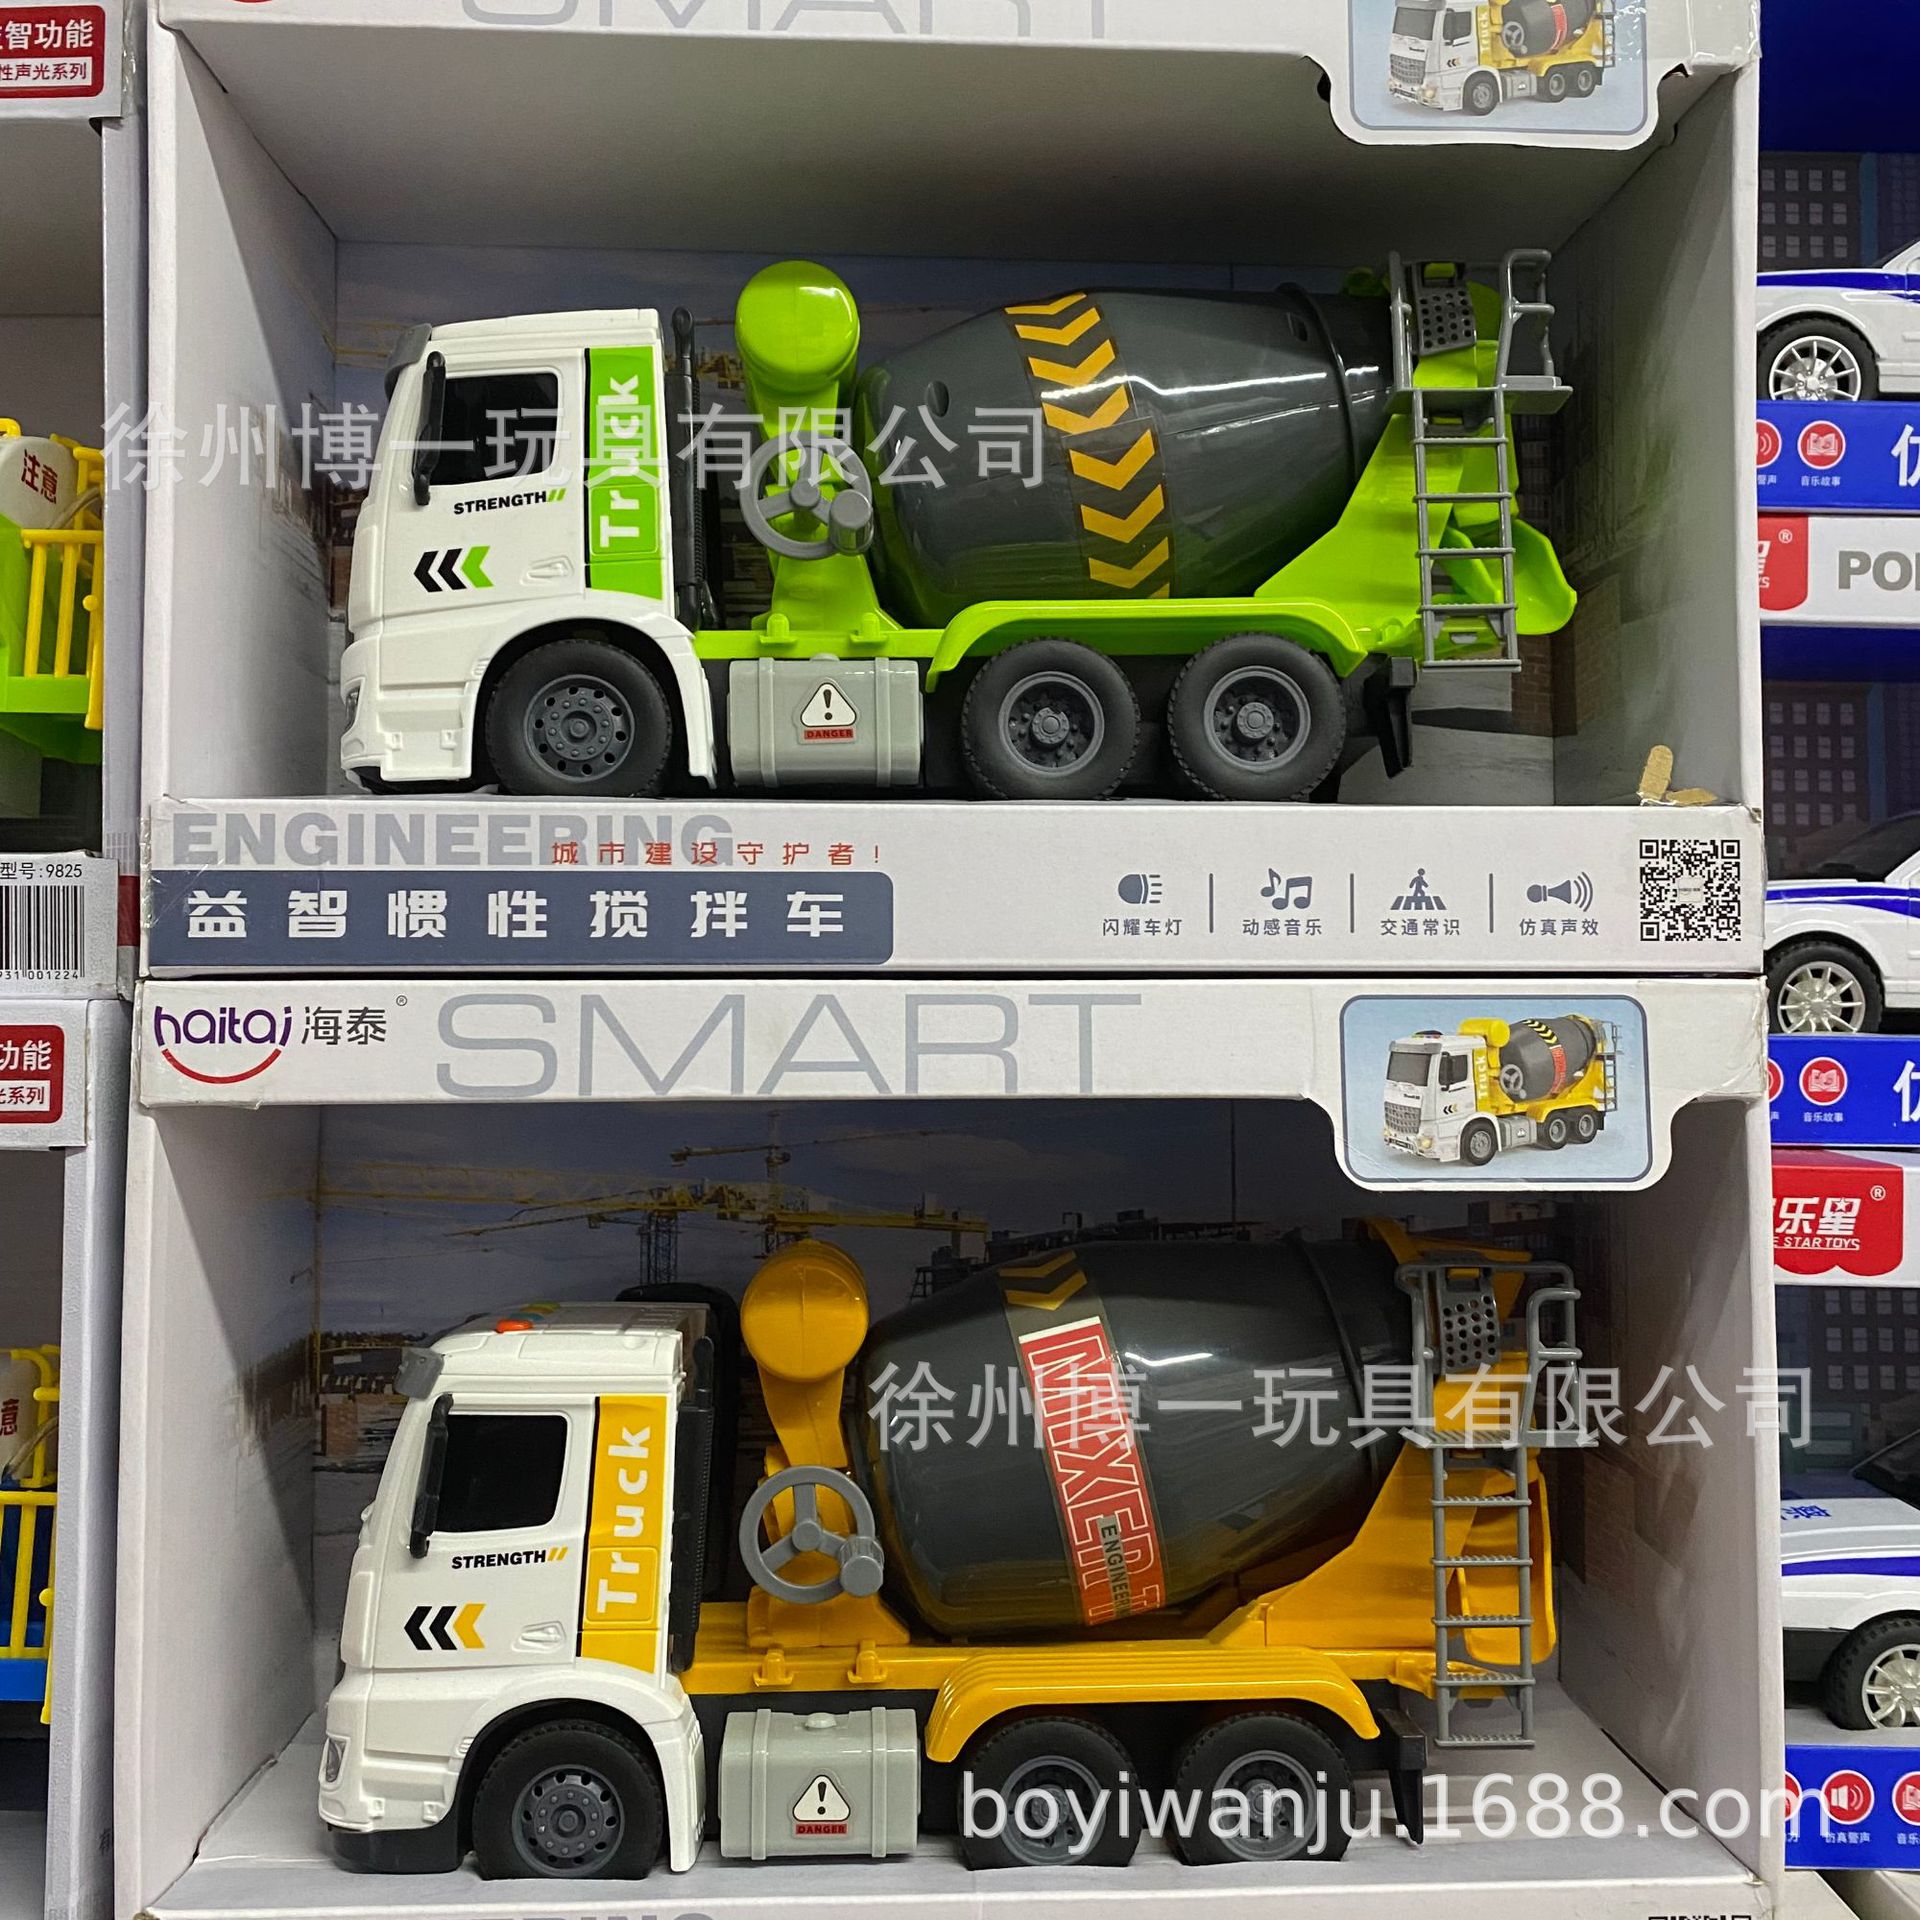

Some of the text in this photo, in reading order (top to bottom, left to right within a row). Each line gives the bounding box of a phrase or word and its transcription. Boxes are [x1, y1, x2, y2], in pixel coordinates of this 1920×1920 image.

[0, 19, 94, 50] 智功能
[21, 448, 58, 505] 注意
[598, 374, 640, 548] Truck
[1838, 550, 1920, 592] PO
[806, 728, 854, 739] DANGER
[173, 812, 734, 867] ENGINEERING
[187, 889, 845, 939] 益智惯性搅拌车
[1102, 918, 1183, 936] 闪耀车灯
[1242, 918, 1322, 936] 动感音乐
[1380, 918, 1460, 936] 交通常识
[1519, 918, 1599, 936] 仿真声效
[301, 1006, 387, 1046] 海泰
[435, 993, 1143, 1098] SMART
[1772, 1197, 1862, 1236] 乐星
[1784, 1237, 1822, 1248] STAR
[1825, 1238, 1861, 1250] TOYS
[597, 1427, 650, 1614] Truck
[797, 1825, 847, 1835] DANGER
[1897, 1833, 1920, 1845] 音乐
